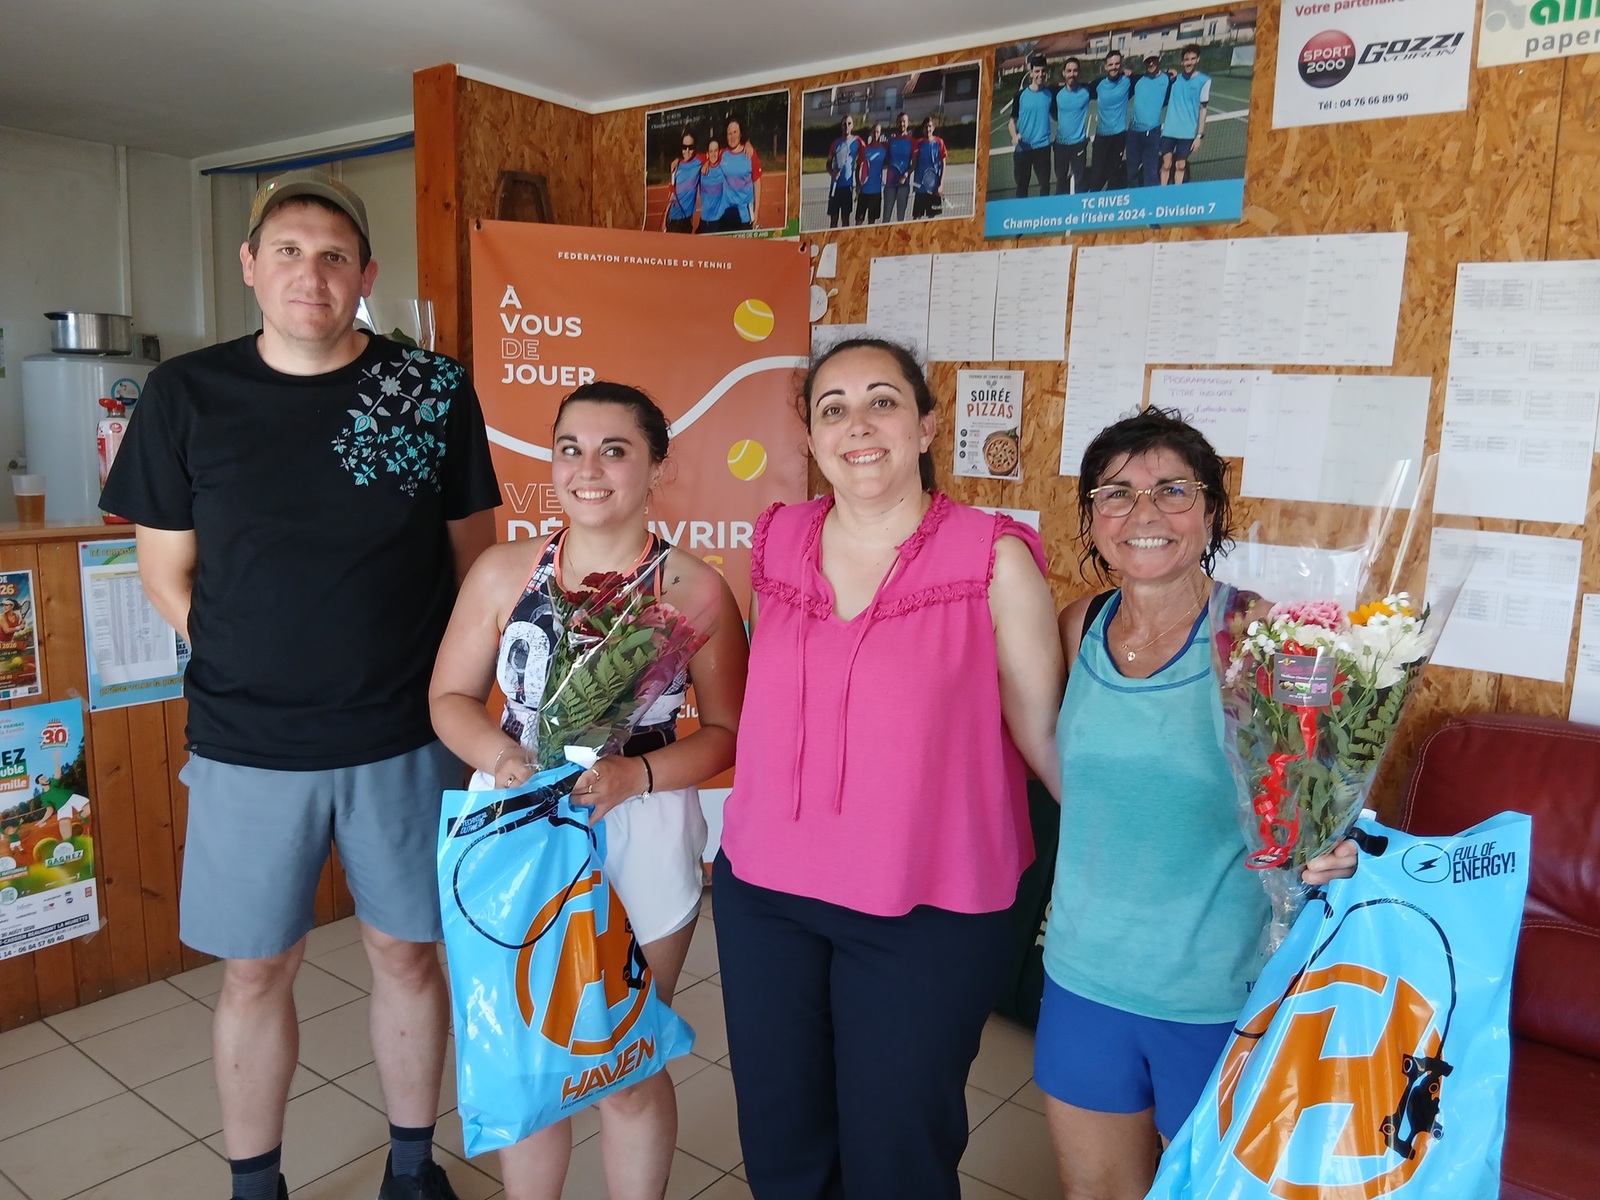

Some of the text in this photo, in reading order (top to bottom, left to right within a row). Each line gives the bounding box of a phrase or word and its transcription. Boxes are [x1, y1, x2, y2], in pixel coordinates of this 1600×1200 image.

[1295, 1, 1330, 17] Votre
[1303, 45, 1352, 62] SPORT
[1306, 58, 1346, 74] 2000
[1318, 101, 1332, 110] Tél
[1340, 99, 1351, 107] 04
[1354, 97, 1366, 106] 76
[1368, 96, 1380, 105] 66
[1382, 94, 1394, 104] 89
[1396, 92, 1409, 102] 90
[1081, 194, 1130, 209] TC RIVES
[1003, 216, 1063, 230] Champions
[1065, 213, 1079, 224] de
[1117, 207, 1146, 221] 2024
[1156, 204, 1203, 217] Division
[1208, 202, 1216, 214] 7
[558, 252, 620, 263] FÉDÉRATION
[624, 256, 679, 267] FRANÇAISE
[698, 261, 732, 270] TENNIS
[500, 284, 522, 309] À
[500, 313, 582, 337] VOUS
[501, 338, 540, 360] DE
[501, 363, 596, 387] JOUER
[971, 387, 1011, 403] SOIRÉE
[967, 402, 1014, 419] PIZZAS
[42, 728, 67, 746] 30
[47, 851, 82, 865] GAGNEZ
[1453, 841, 1497, 861] FULL OF
[1453, 852, 1516, 884] ENERGY!
[562, 1031, 656, 1104] HAVEN
